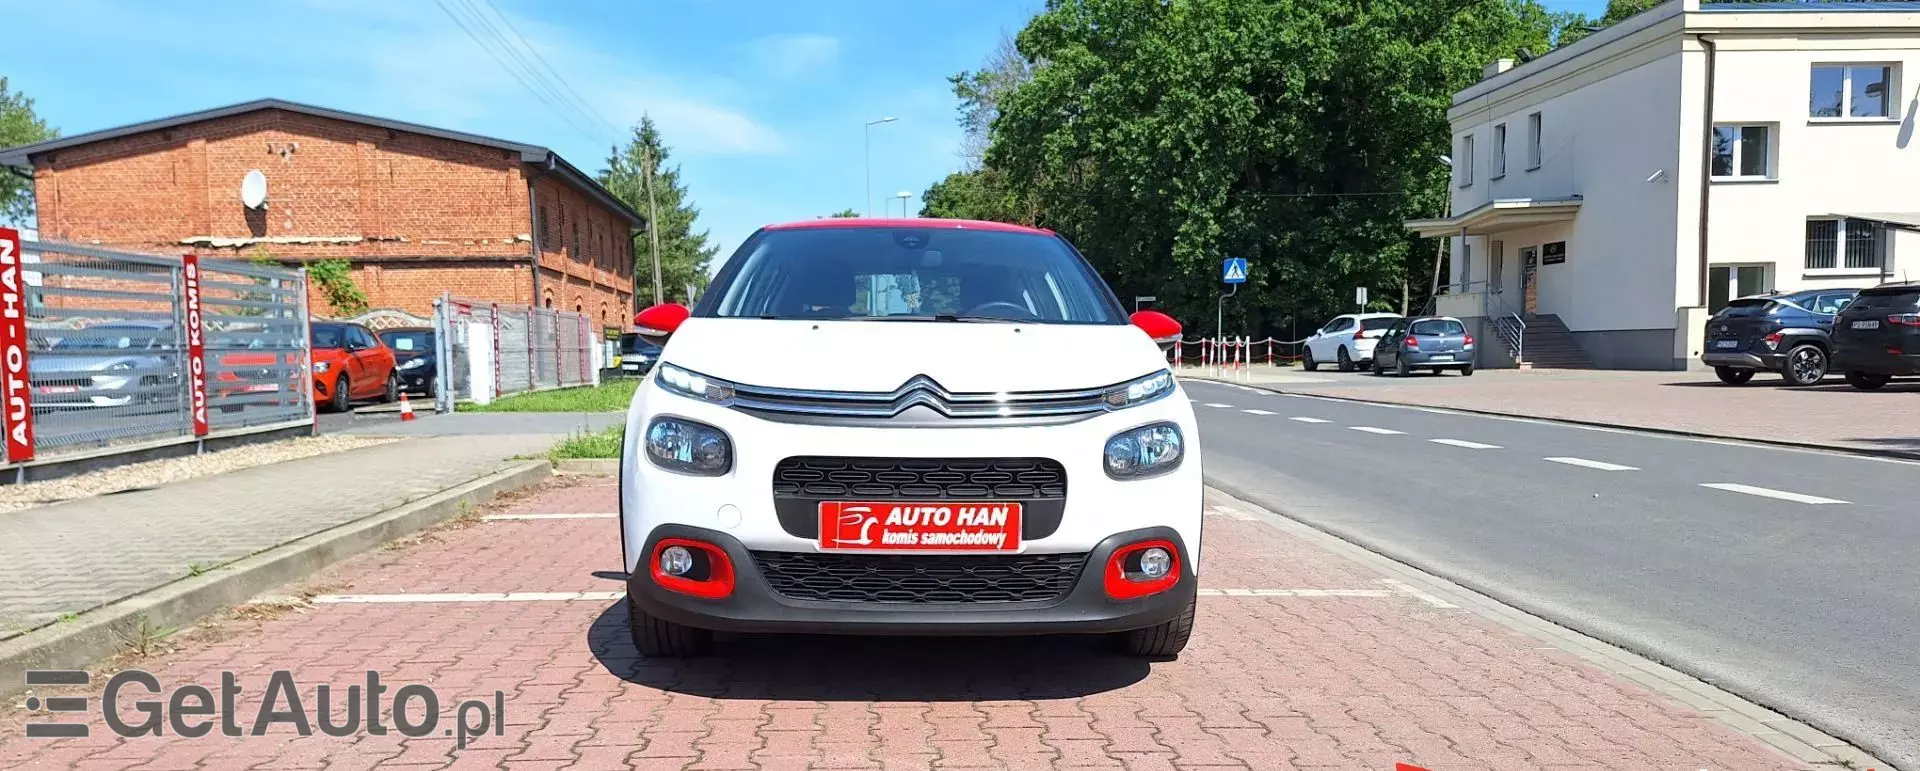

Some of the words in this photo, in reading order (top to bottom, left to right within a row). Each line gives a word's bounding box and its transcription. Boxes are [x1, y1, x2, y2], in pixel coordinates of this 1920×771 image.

[0, 238, 19, 319] HAN
[186, 262, 200, 345] KOMIS
[7, 344, 28, 447] AUTO
[193, 356, 205, 424] AUTO
[882, 528, 919, 544] komis
[920, 528, 1006, 550] samochodowy
[885, 507, 951, 526] AUTO
[957, 507, 1009, 526] HAN
